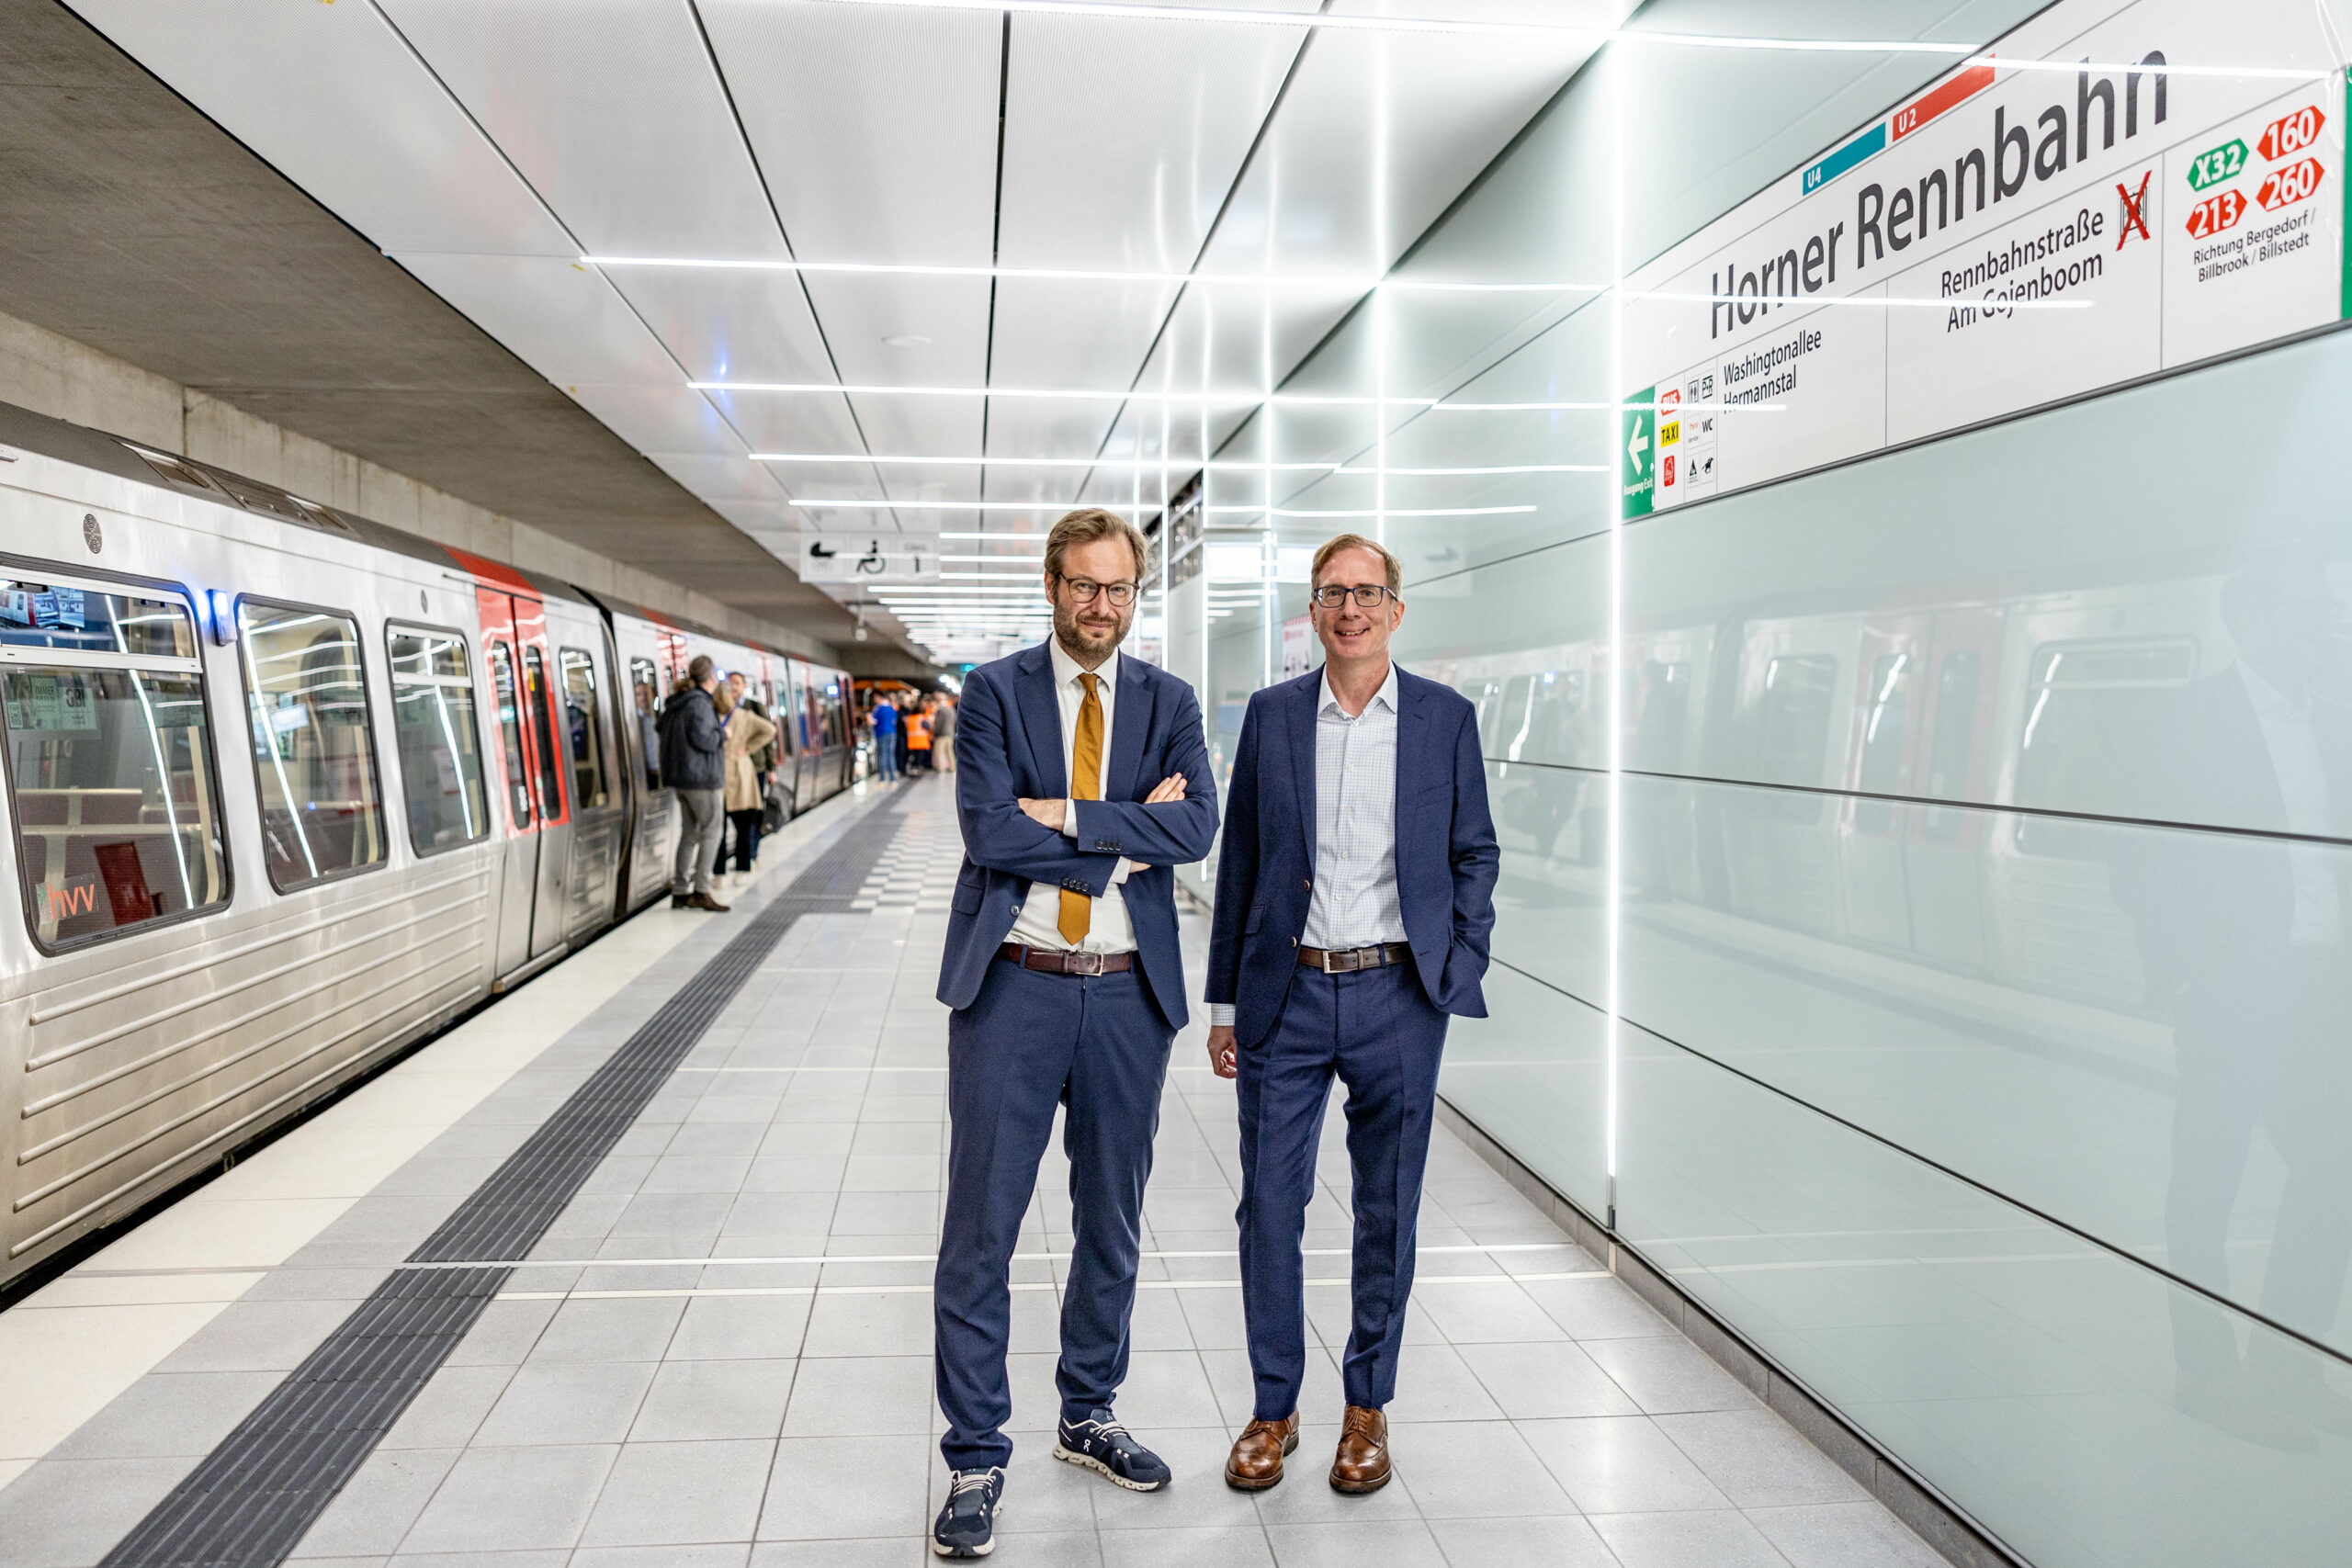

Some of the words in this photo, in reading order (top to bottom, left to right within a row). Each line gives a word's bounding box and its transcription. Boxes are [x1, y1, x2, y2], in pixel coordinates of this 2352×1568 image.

[1898, 108, 1917, 133] U2
[2195, 144, 2241, 188] X32
[2267, 107, 2315, 159] 160
[1712, 221, 1843, 339] Horner
[1857, 50, 2167, 270] Rennbahn
[1807, 166, 1821, 188] U4
[2194, 192, 2237, 239] 213
[2266, 159, 2315, 210] 260
[1941, 208, 2103, 299] Rennbahnstraße
[2193, 237, 2244, 265] Richtung
[2246, 209, 2309, 247] Bergedorf
[2199, 252, 2250, 283] Billbrook
[2259, 231, 2310, 262] Billstedt
[1947, 305, 1976, 333] Am
[1982, 254, 2102, 319] Gojenboom
[1724, 329, 1822, 387] Washingtonallee
[1724, 364, 1796, 414] Hermannstal
[1661, 423, 1679, 445] TAXI
[1702, 418, 1713, 433] WC
[1644, 476, 1654, 491] Exit
[47, 884, 95, 919] hvv
